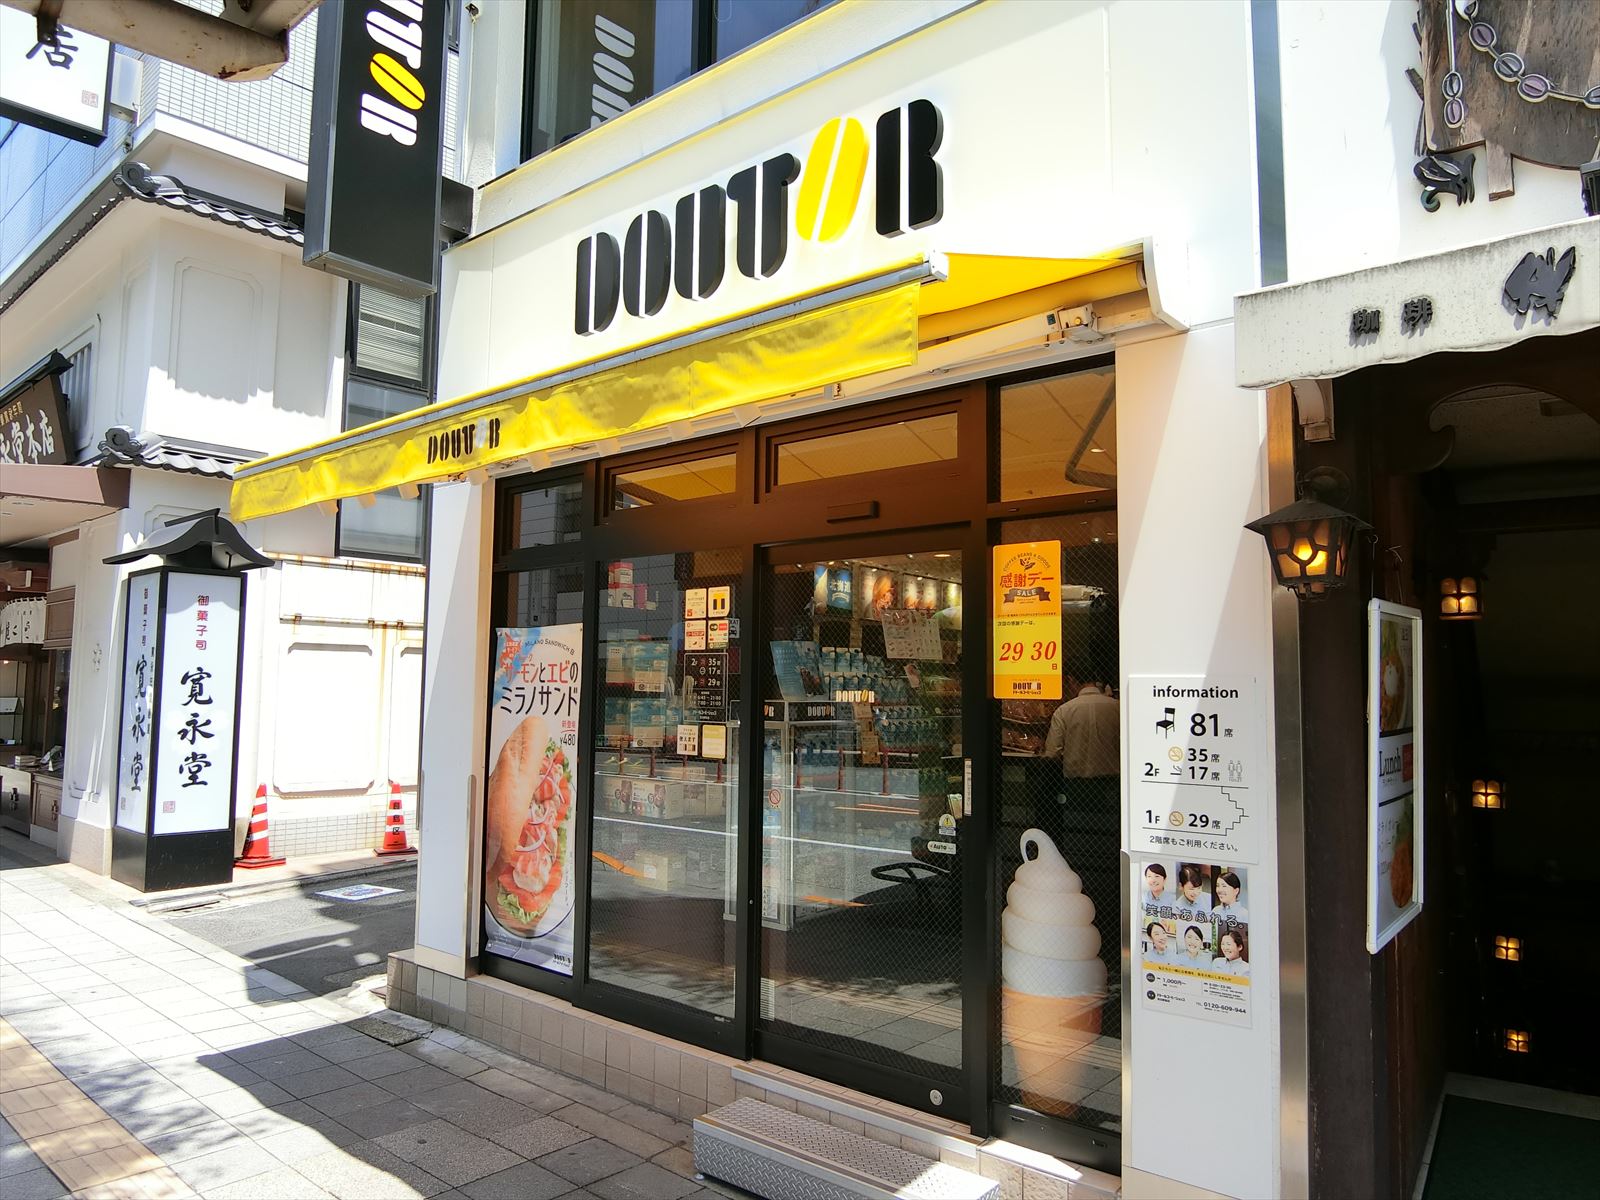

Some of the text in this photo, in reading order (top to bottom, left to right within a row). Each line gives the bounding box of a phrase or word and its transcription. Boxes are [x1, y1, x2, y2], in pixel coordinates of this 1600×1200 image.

[360, 0, 425, 146] TOR
[574, 98, 944, 336] DOUTOR
[1353, 298, 1433, 335] 珈琲
[427, 417, 500, 464] DOUTOR
[1000, 572, 1054, 588] 感謝デー
[1017, 589, 1037, 597] SALE
[195, 594, 209, 651] 御菓子司
[999, 641, 1057, 662] 29 30
[500, 685, 578, 717] ミラノサンド
[1153, 685, 1239, 699] information
[178, 667, 215, 788] 寛永堂
[1144, 762, 1160, 777] 2F
[1145, 810, 1160, 824] 1F
[1149, 835, 1239, 852] 2階席もご利用ください。
[1145, 903, 1244, 929] 笑顔、あふれる。
[1203, 1001, 1247, 1014] 0120-609-944
